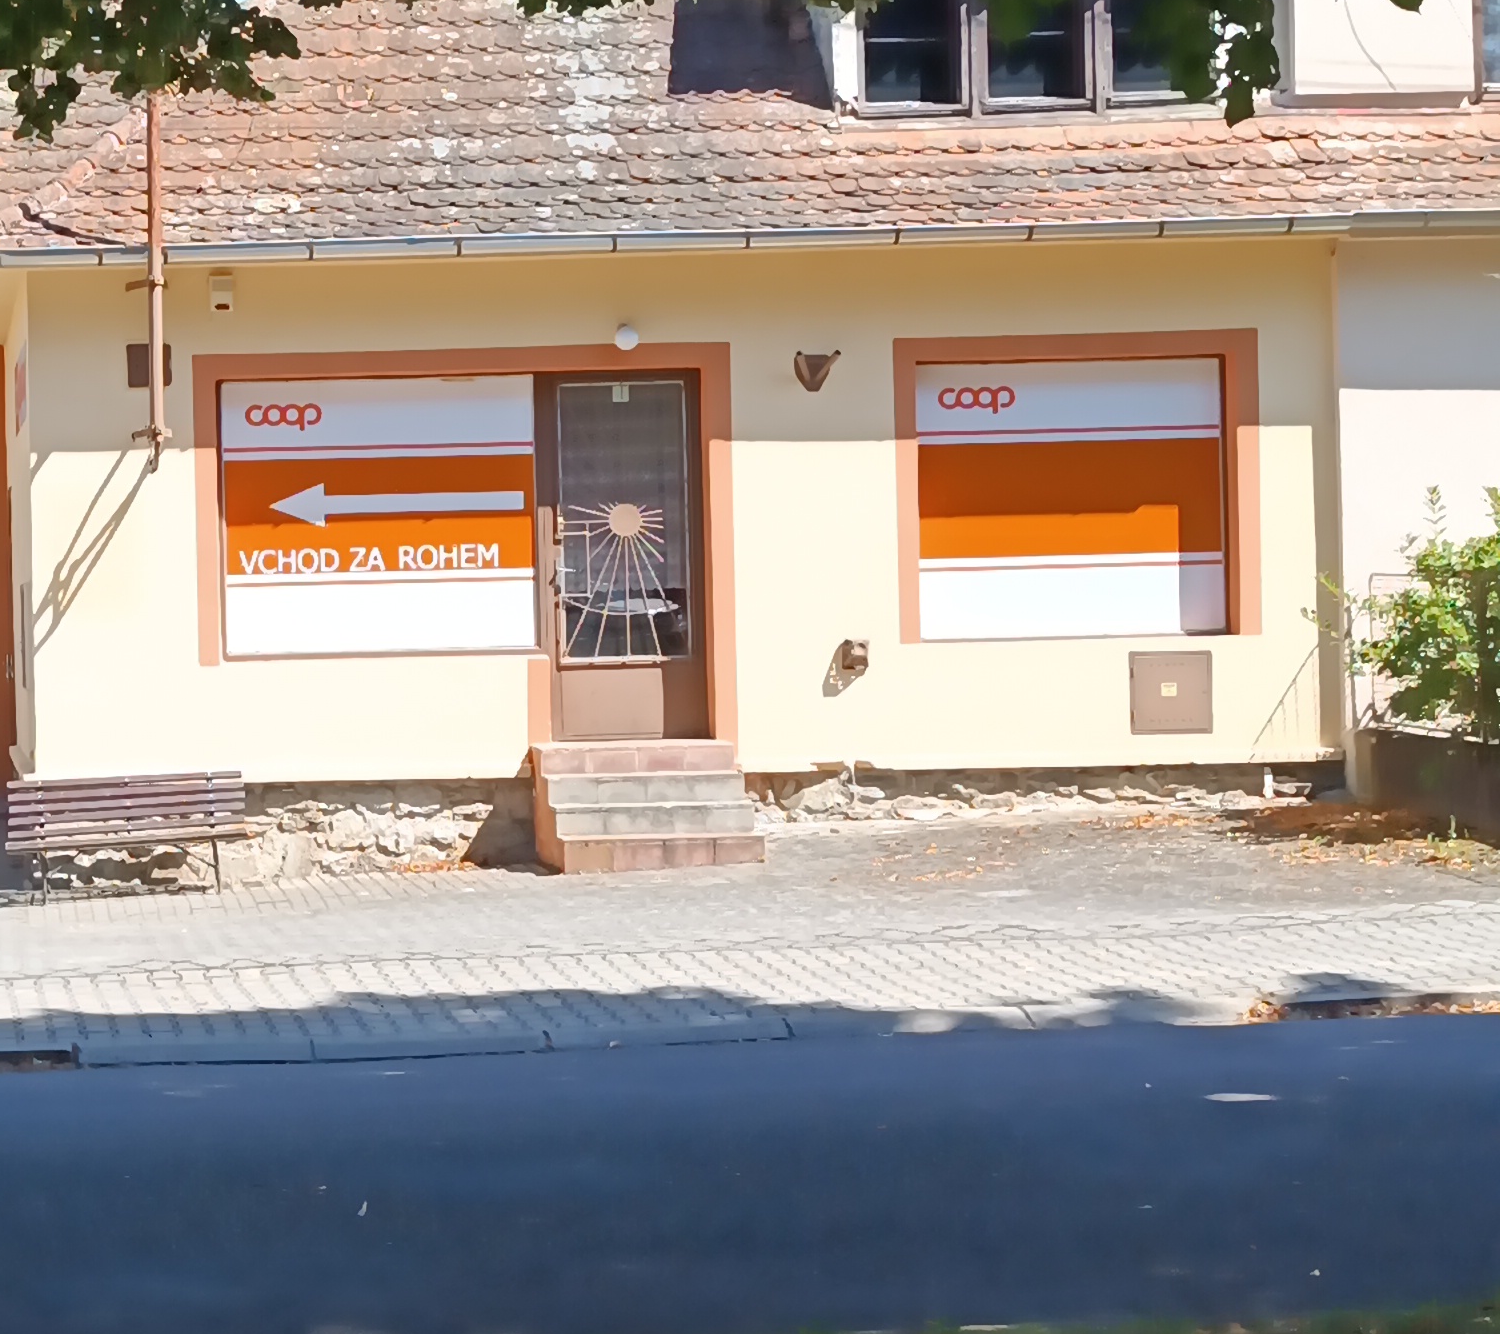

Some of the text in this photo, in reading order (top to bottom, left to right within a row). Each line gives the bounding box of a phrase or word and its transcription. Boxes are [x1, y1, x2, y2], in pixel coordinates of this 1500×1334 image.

[938, 386, 1015, 414] coop
[245, 403, 322, 431] coop
[239, 543, 499, 574] VCHOD ZA ROHEM
